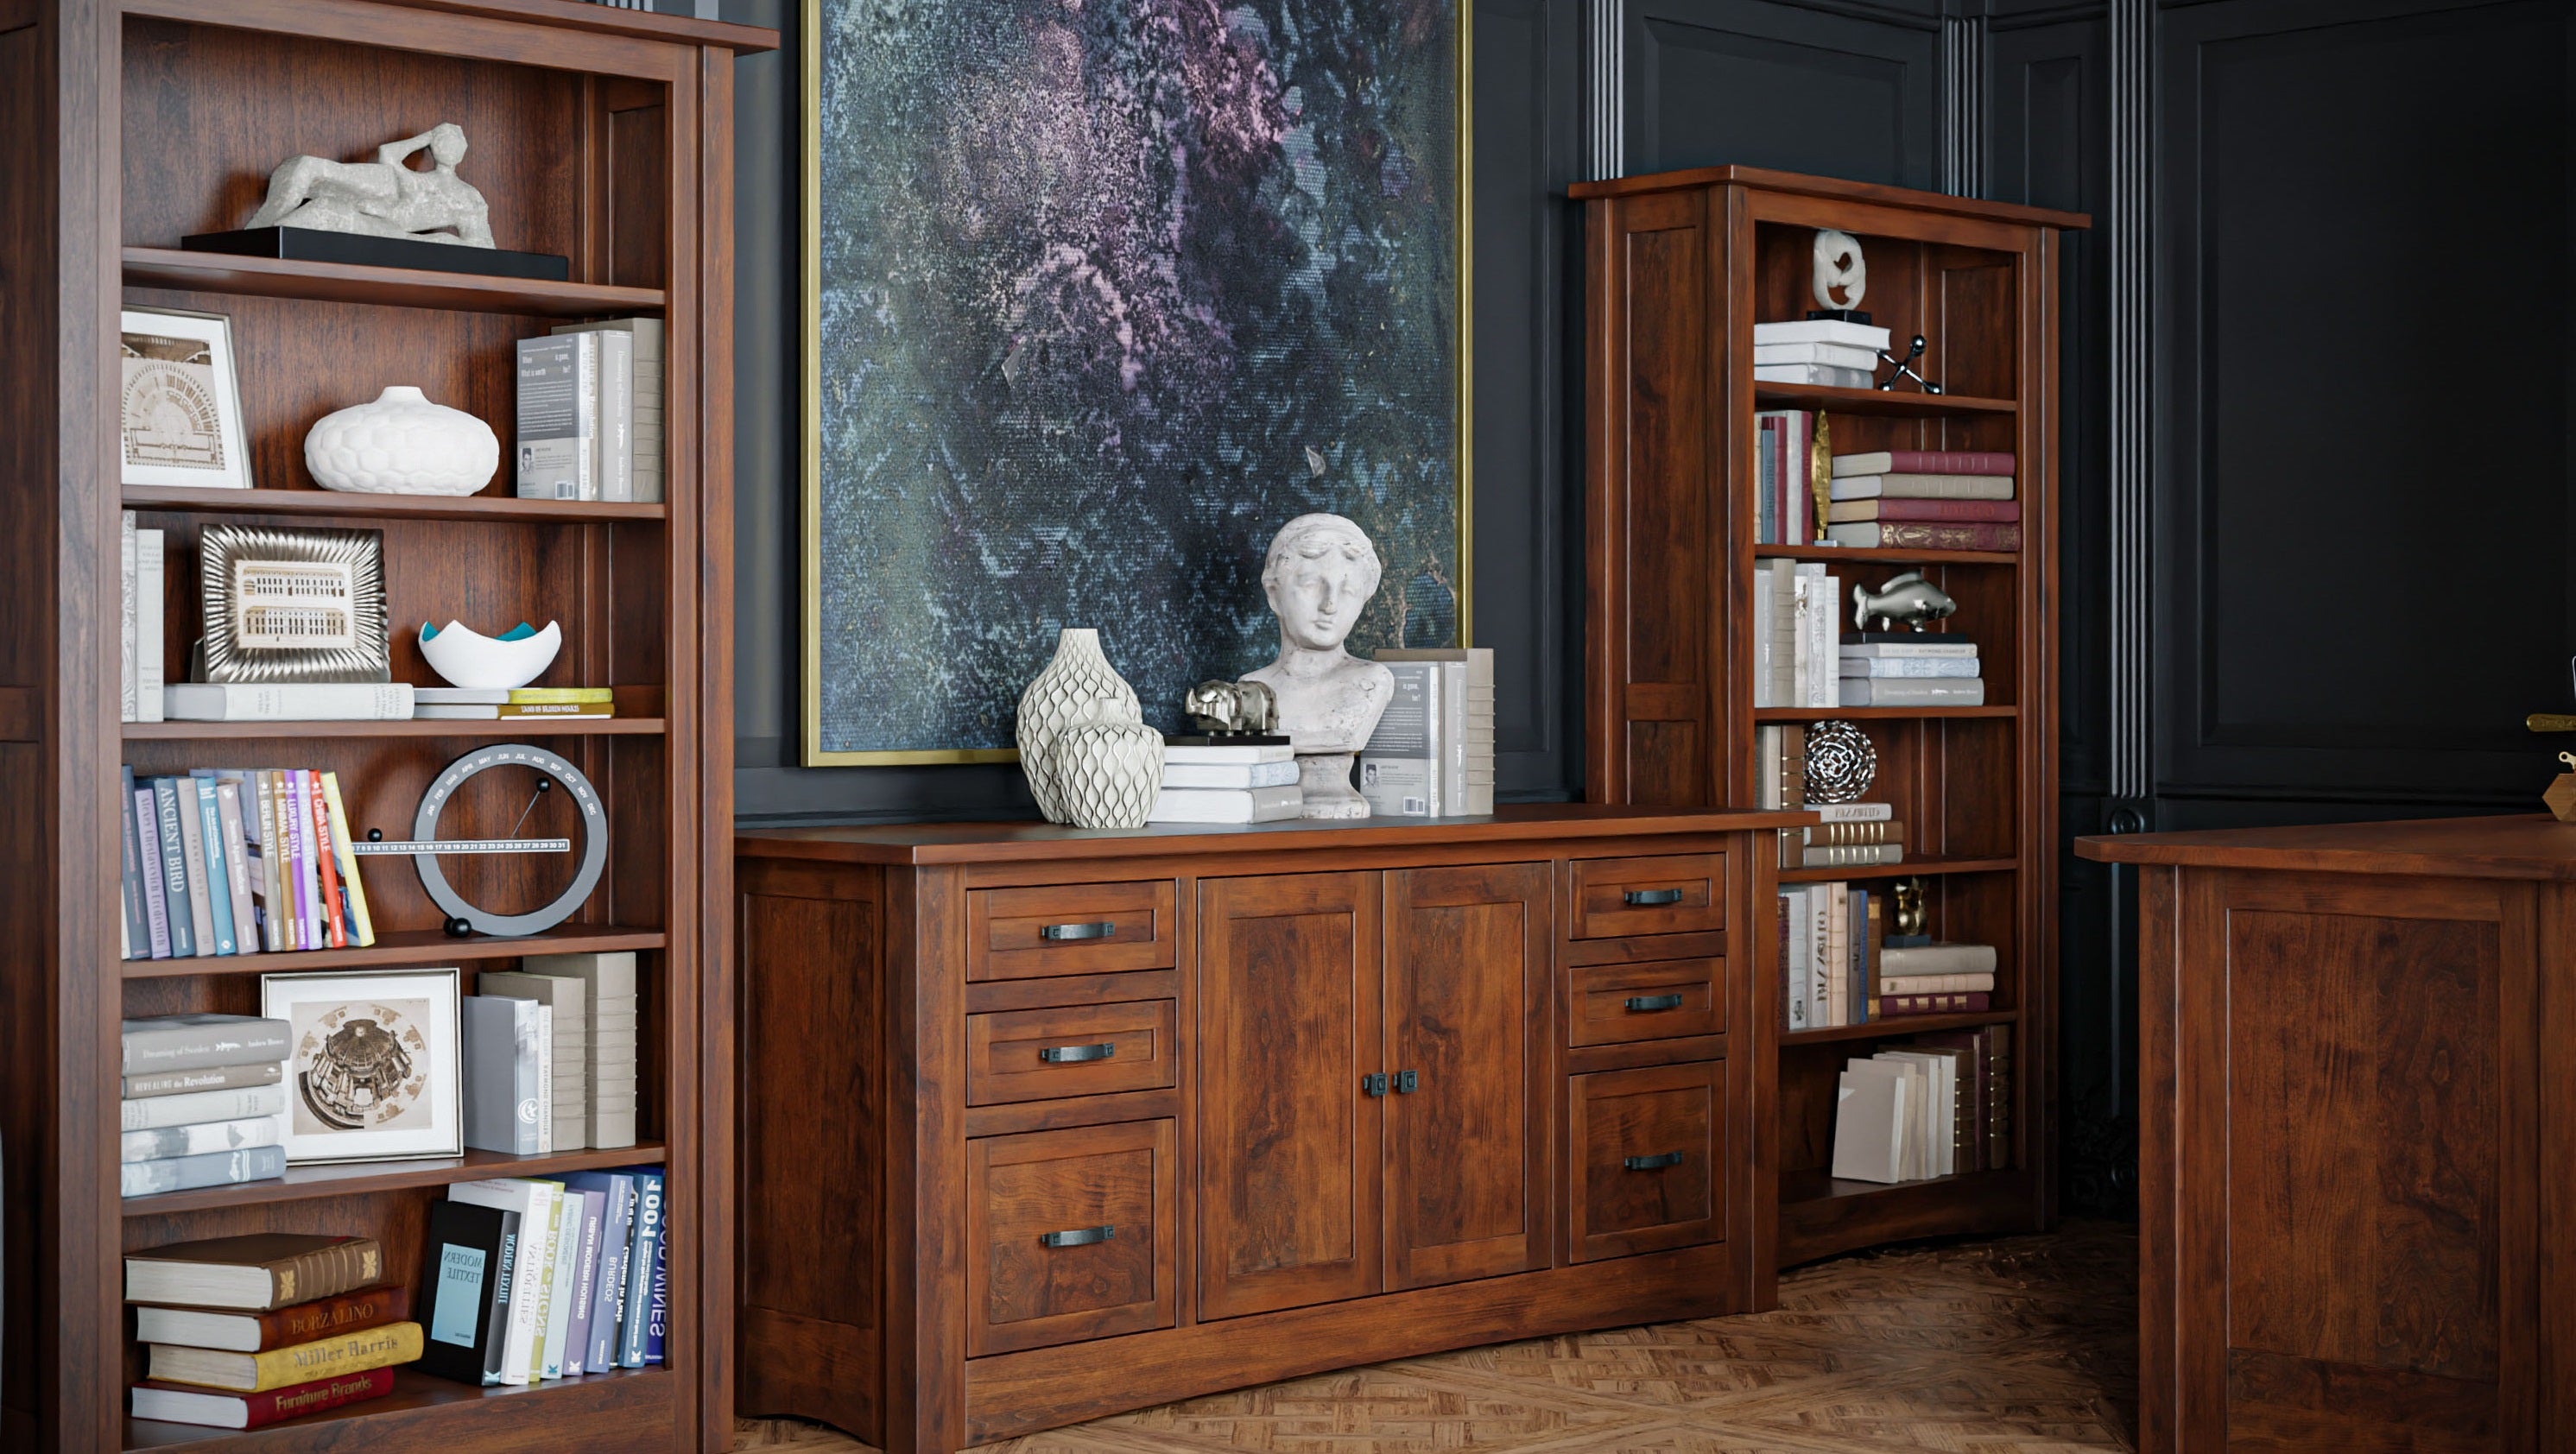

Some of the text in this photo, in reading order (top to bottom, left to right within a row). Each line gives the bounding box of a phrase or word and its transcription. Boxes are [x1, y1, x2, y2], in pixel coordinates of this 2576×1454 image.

[434, 787, 445, 801] FEB
[446, 773, 459, 786] MAR
[461, 762, 474, 774] APR
[478, 755, 491, 765] MAY
[531, 755, 545, 765] AUG
[549, 762, 562, 774] SEP
[565, 772, 577, 784] OCT
[577, 786, 589, 800] NOV
[585, 803, 598, 816] DEC
[161, 787, 185, 893] ANCIENT BIRD
[261, 800, 275, 858] BERLIN STYLE
[276, 798, 290, 863] MINIMAL STYLE
[287, 798, 301, 860] LUXURY STYLE
[314, 798, 331, 853] CHINA STYLE
[174, 1079, 183, 1088] the
[184, 1074, 225, 1088] Revolution
[291, 1304, 373, 1335] BORZALINO
[294, 1347, 344, 1368] Miller
[347, 1335, 398, 1357] Harris
[275, 1375, 372, 1412] Furniture Brands
